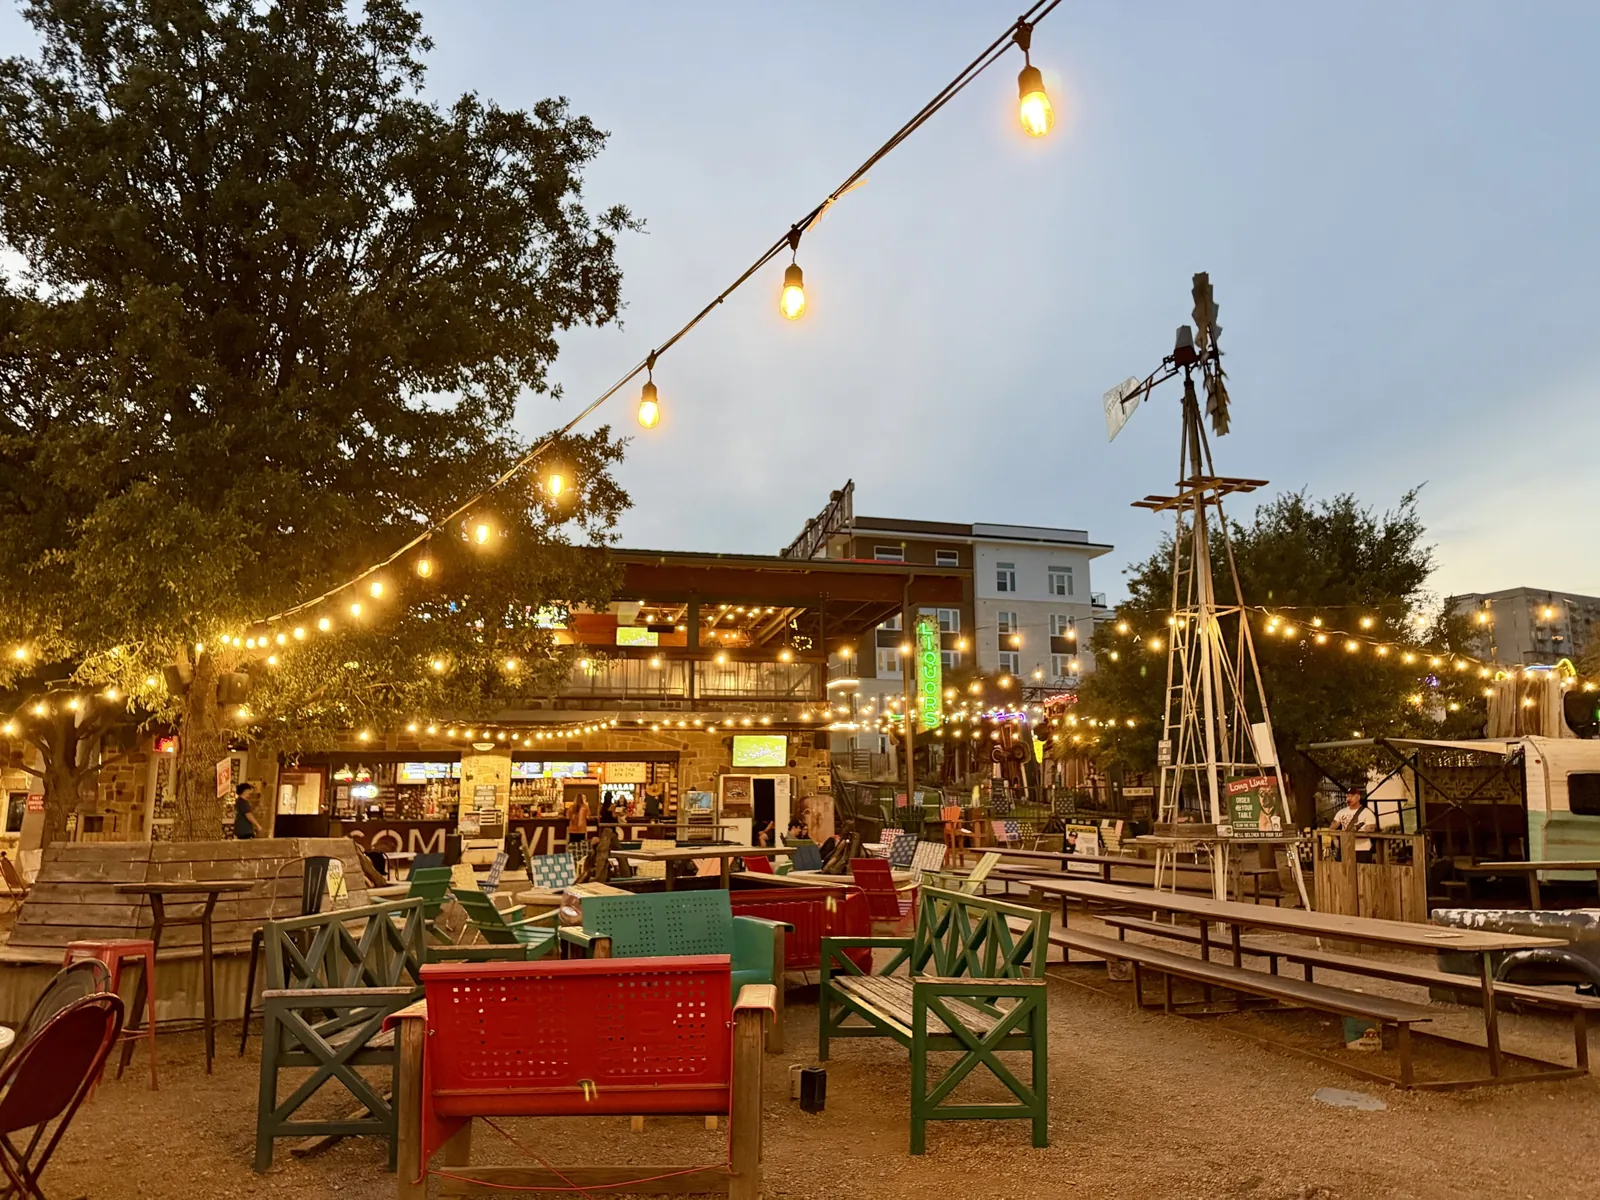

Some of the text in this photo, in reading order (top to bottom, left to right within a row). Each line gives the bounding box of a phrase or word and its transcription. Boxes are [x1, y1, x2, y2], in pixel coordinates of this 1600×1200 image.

[920, 622, 938, 726] LIQUORS
[1229, 776, 1268, 792] Long Line?
